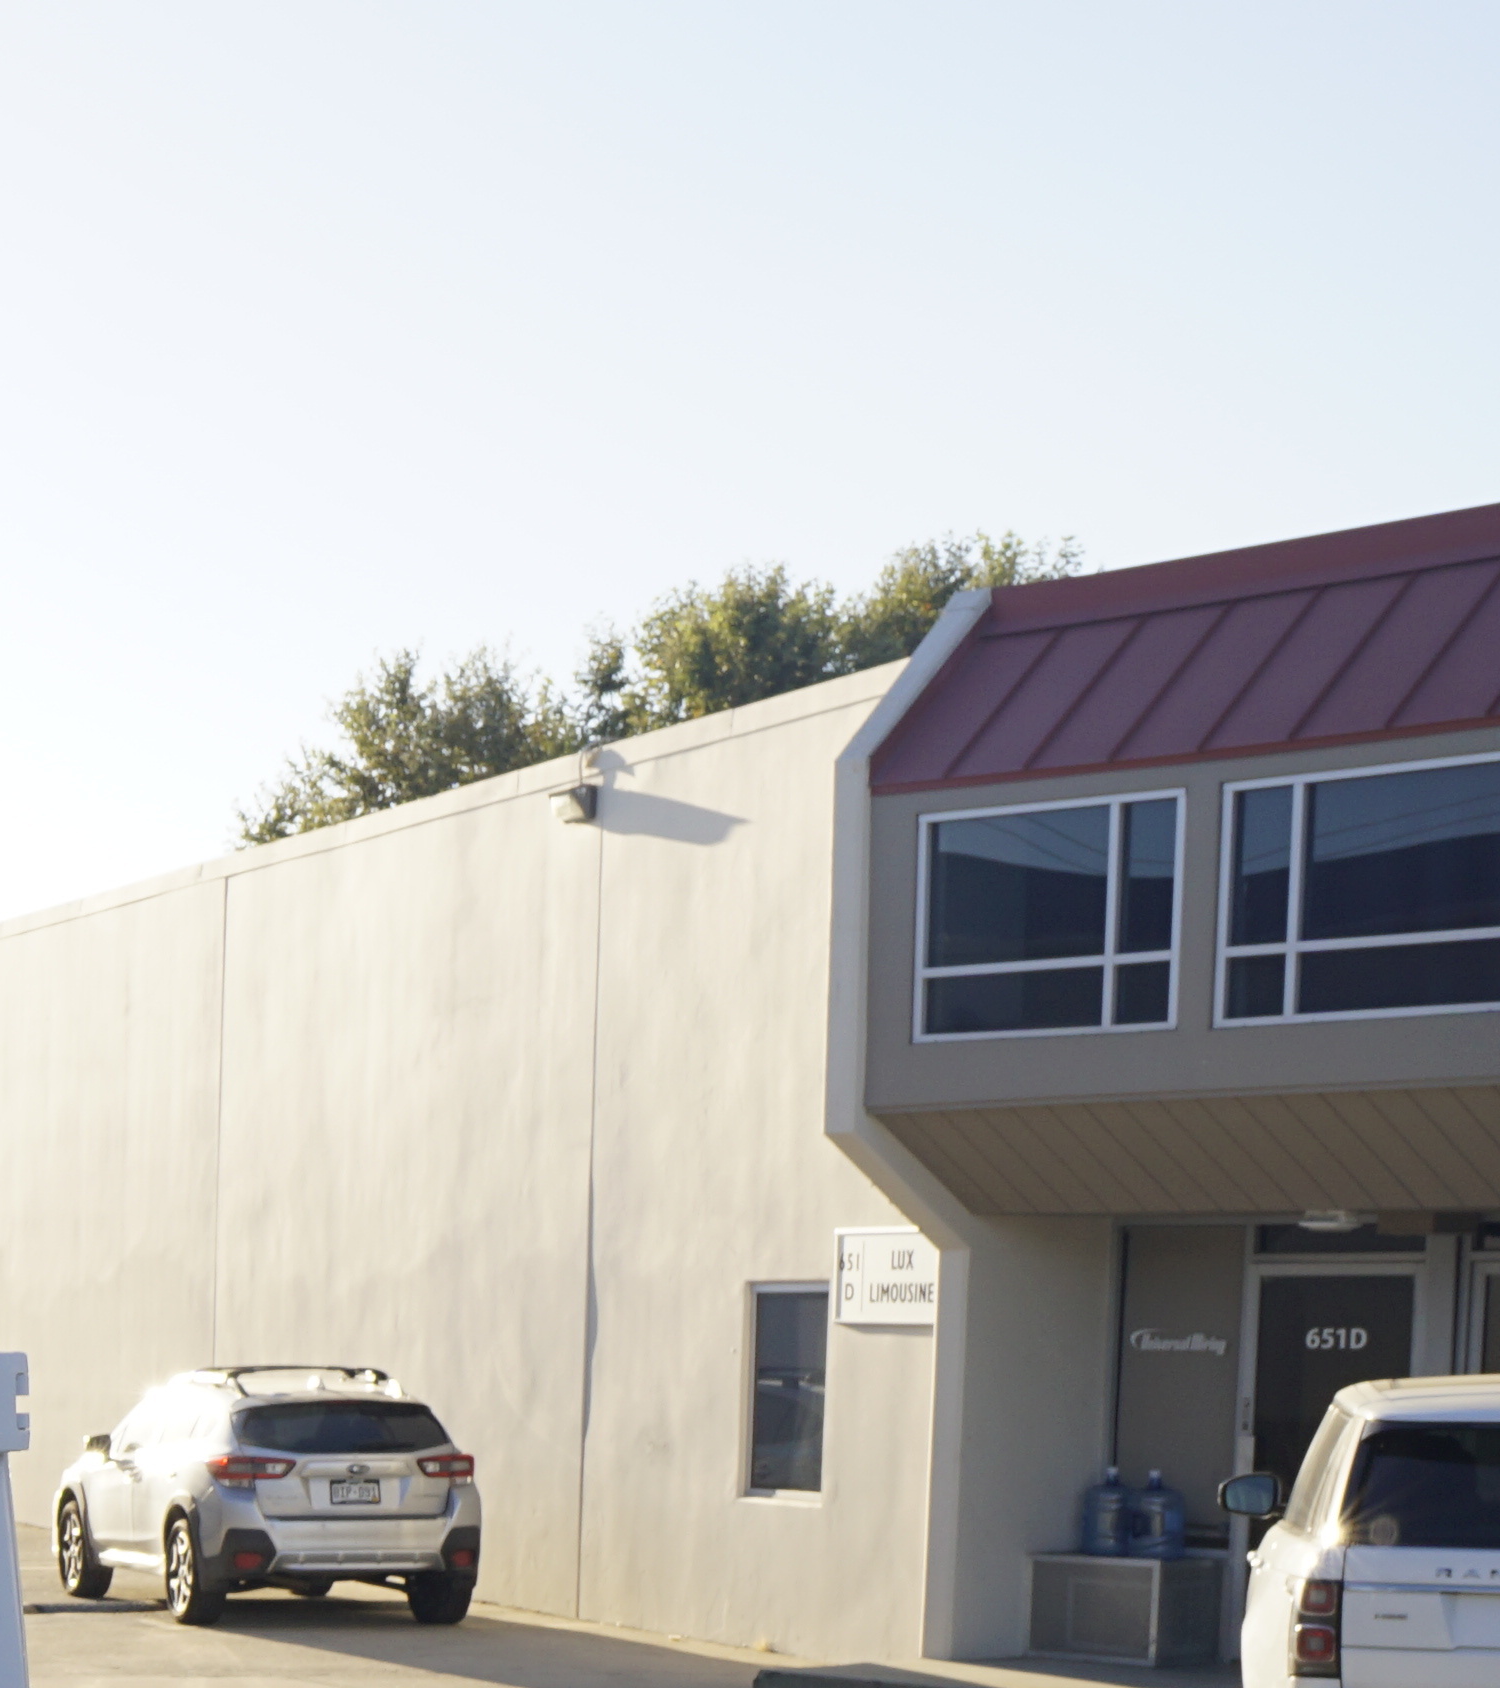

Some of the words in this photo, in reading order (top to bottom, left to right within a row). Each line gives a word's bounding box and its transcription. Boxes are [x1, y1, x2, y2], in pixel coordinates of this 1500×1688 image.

[891, 1249, 915, 1270] LUX
[844, 1283, 855, 1301] D
[869, 1282, 934, 1303] LIMOUSINE
[1305, 1327, 1368, 1350] 651D
